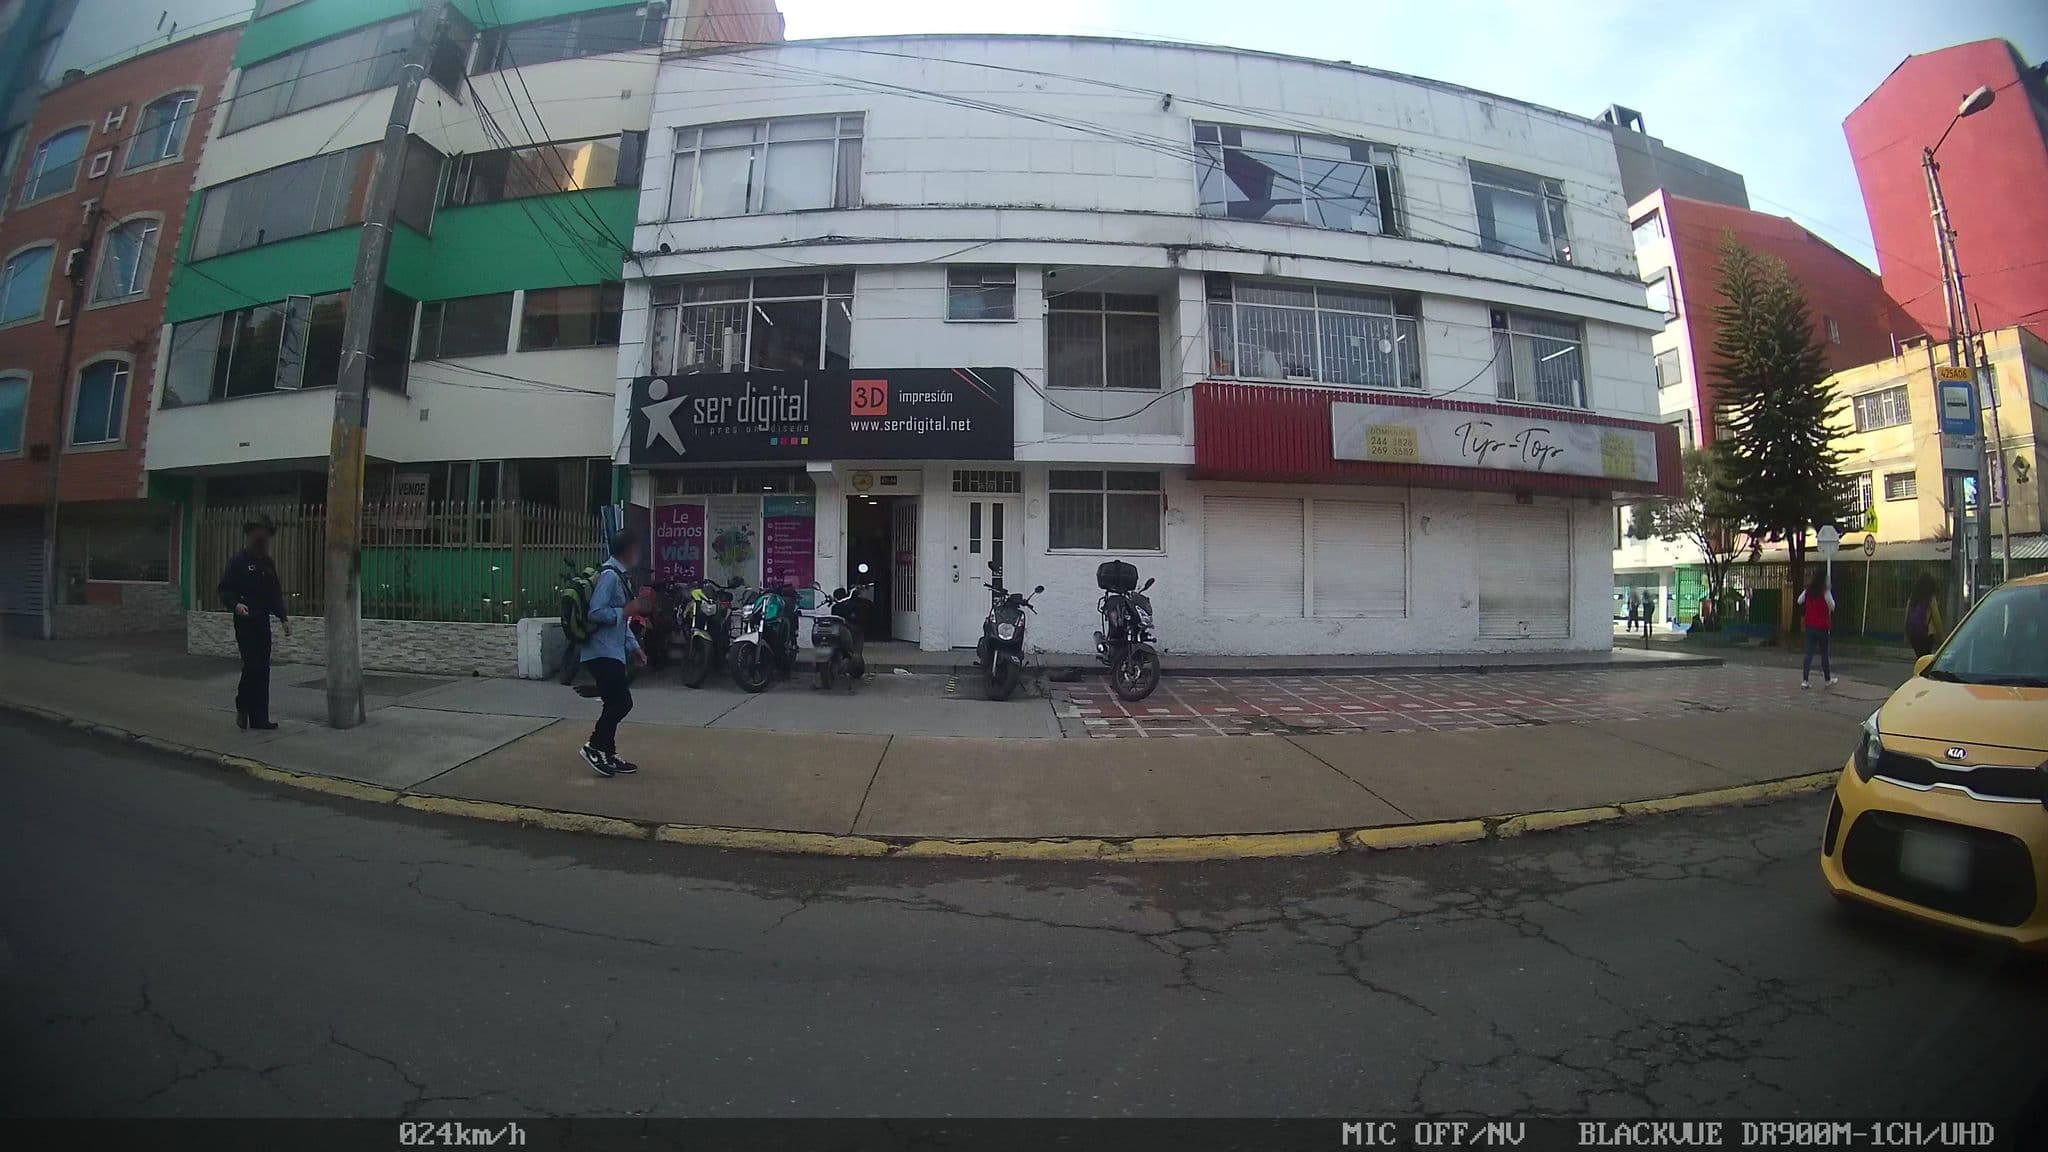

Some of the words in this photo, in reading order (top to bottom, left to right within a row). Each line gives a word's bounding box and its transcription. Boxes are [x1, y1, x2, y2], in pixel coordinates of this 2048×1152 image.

[854, 387, 885, 408] 3D
[899, 389, 954, 405] impresión
[693, 397, 732, 424] ser
[737, 379, 809, 431] digital
[850, 416, 971, 434] www.serdigital.net
[1371, 436, 1388, 446] 244
[1372, 446, 1388, 456] 269
[1393, 447, 1414, 457] 362
[399, 482, 426, 496] VENDE
[672, 508, 689, 523] Le
[657, 525, 702, 538] damos
[660, 538, 700, 561] vida
[1947, 748, 1964, 758] KIA
